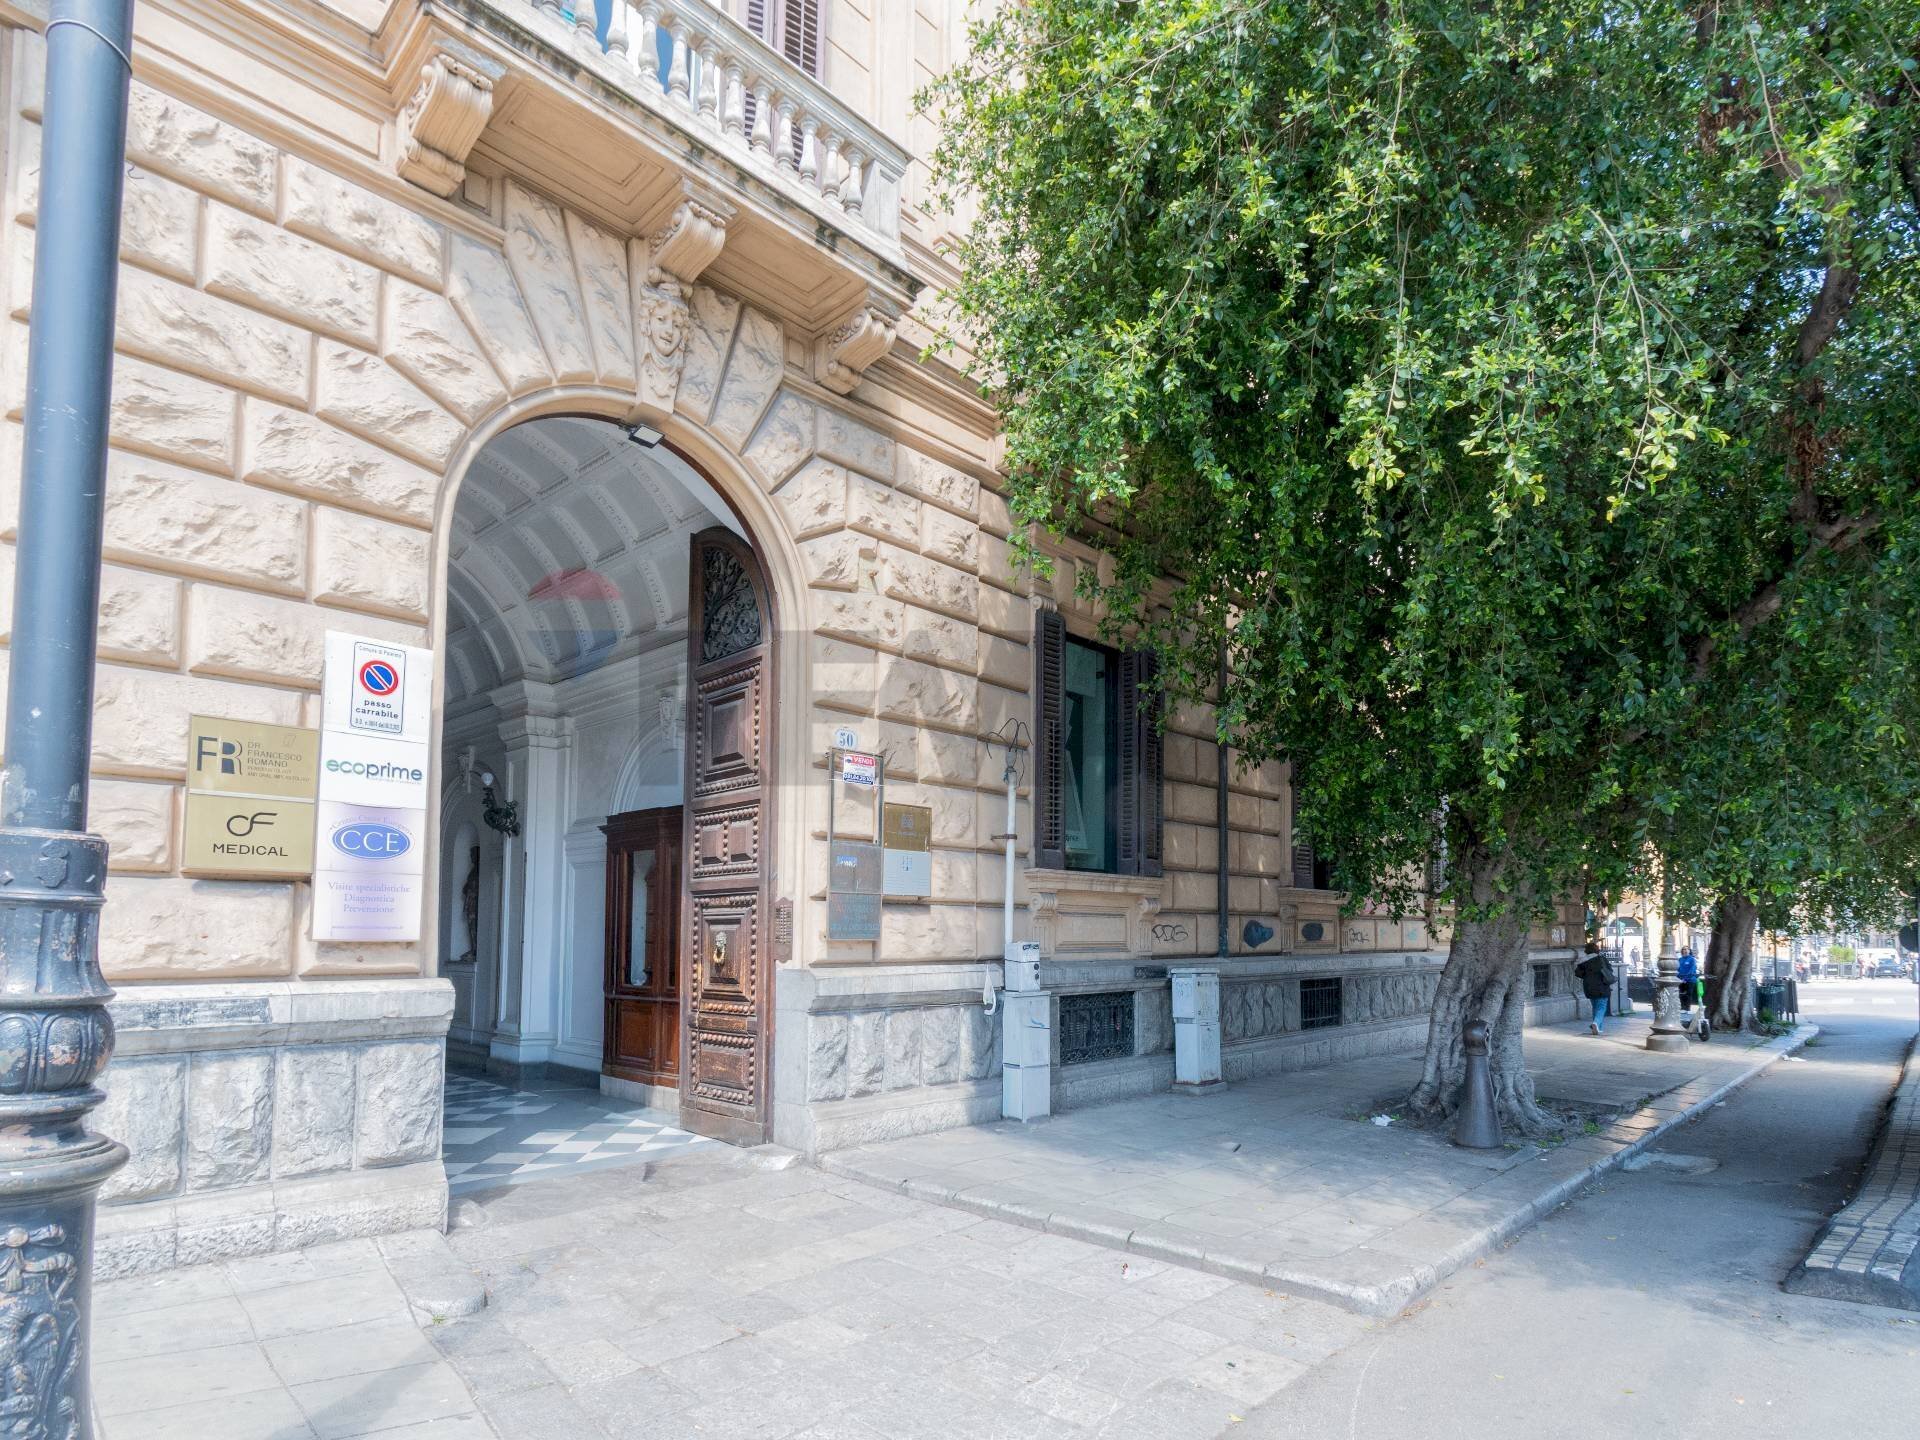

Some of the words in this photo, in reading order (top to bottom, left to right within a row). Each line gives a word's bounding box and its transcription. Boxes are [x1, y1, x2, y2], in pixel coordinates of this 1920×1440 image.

[364, 700, 392, 709] passo
[356, 708, 399, 719] carrabile
[839, 732, 854, 747] 50
[247, 750, 302, 762] FRANCESCO
[247, 758, 288, 768] ROMANO
[326, 759, 422, 781] ecoprime
[340, 830, 400, 852] CCE
[212, 843, 288, 856] MEDICAL
[328, 880, 353, 890] Visite
[355, 882, 411, 893] specialistiche
[344, 894, 395, 904] Diagnostica
[344, 904, 395, 913] Prevenzione
